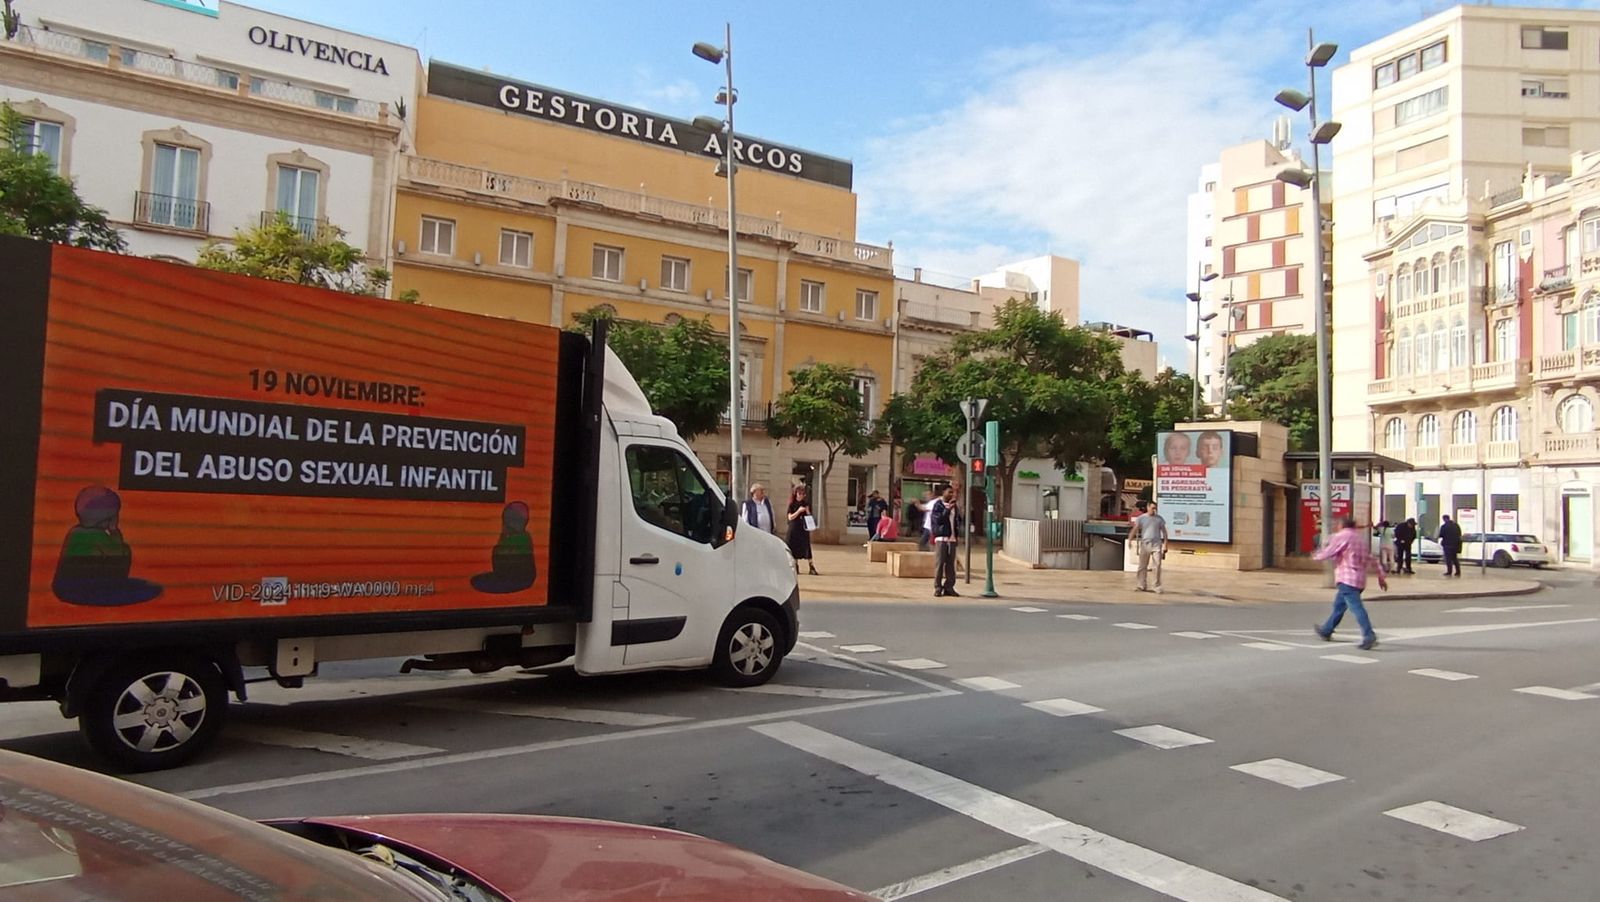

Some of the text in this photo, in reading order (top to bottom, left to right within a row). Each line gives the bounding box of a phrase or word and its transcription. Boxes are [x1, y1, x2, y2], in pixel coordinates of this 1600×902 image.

[248, 26, 390, 76] OLIVENCIA
[499, 84, 803, 174] GESTORIA ARCOS
[249, 368, 427, 408] 19 NOVIEMBRE:
[107, 399, 518, 456] DÍA MUNDIAL DE LA PREVENCIÓN
[133, 450, 499, 492] DEL ABUSO SEXUAL INFANTIL
